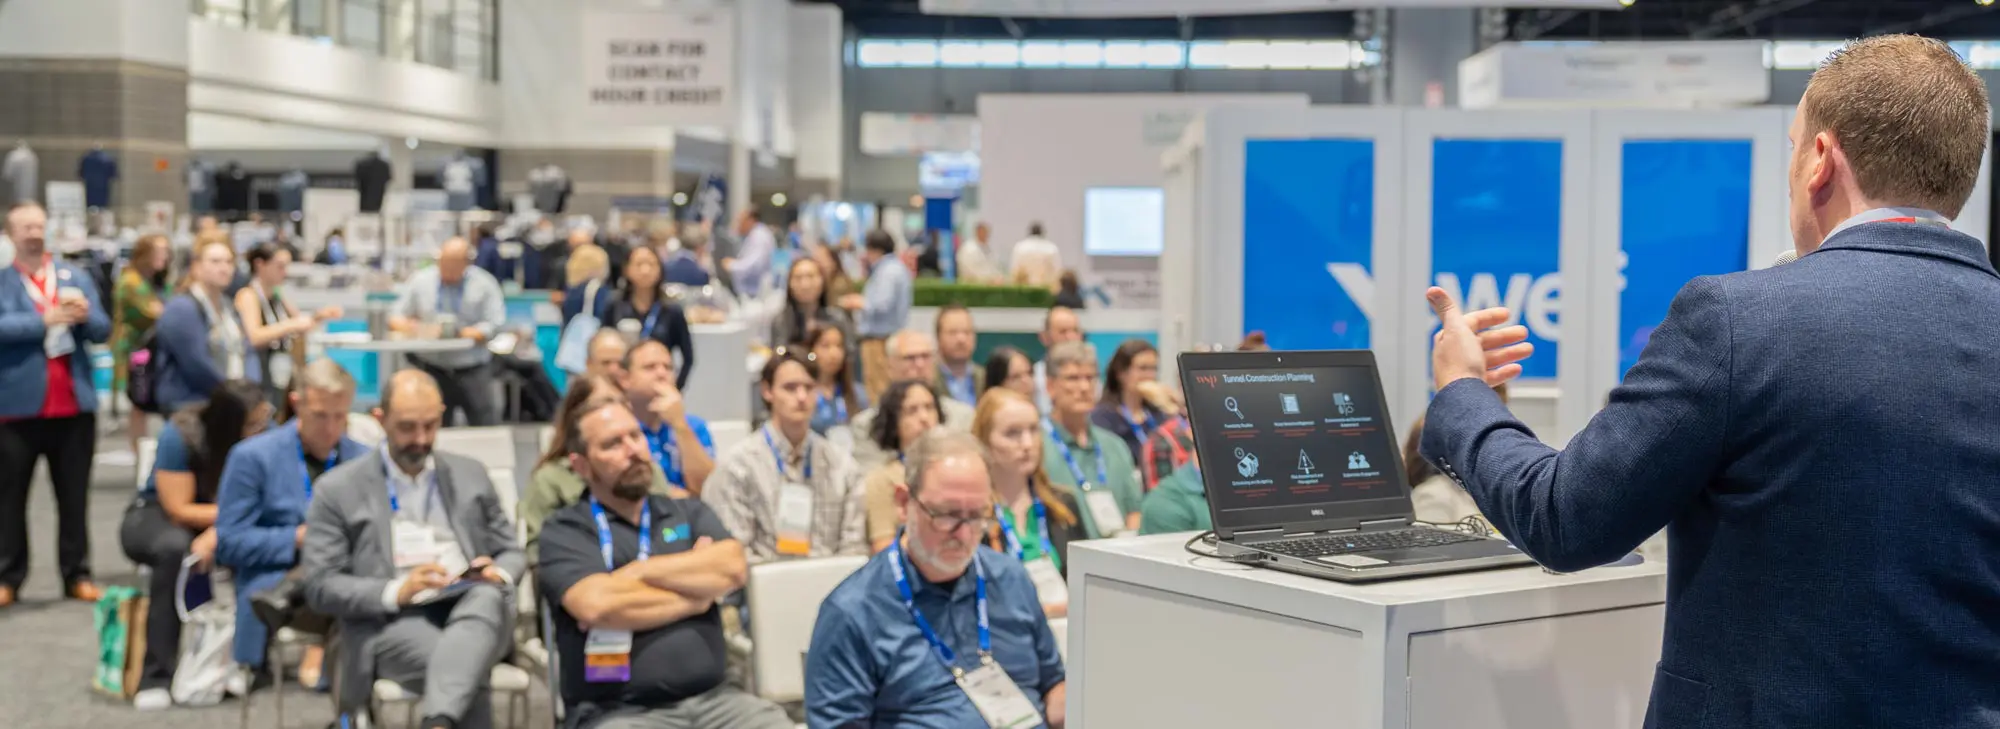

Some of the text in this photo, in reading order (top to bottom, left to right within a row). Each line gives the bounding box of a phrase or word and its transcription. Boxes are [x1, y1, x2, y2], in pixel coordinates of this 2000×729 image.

[608, 40, 705, 57] SCAN FOR
[607, 64, 700, 81] CONTACT
[590, 87, 723, 104] HOUR CREDIT
[1222, 373, 1245, 383] Tunnel
[1245, 373, 1287, 383] Construction
[1286, 372, 1316, 384] Planning
